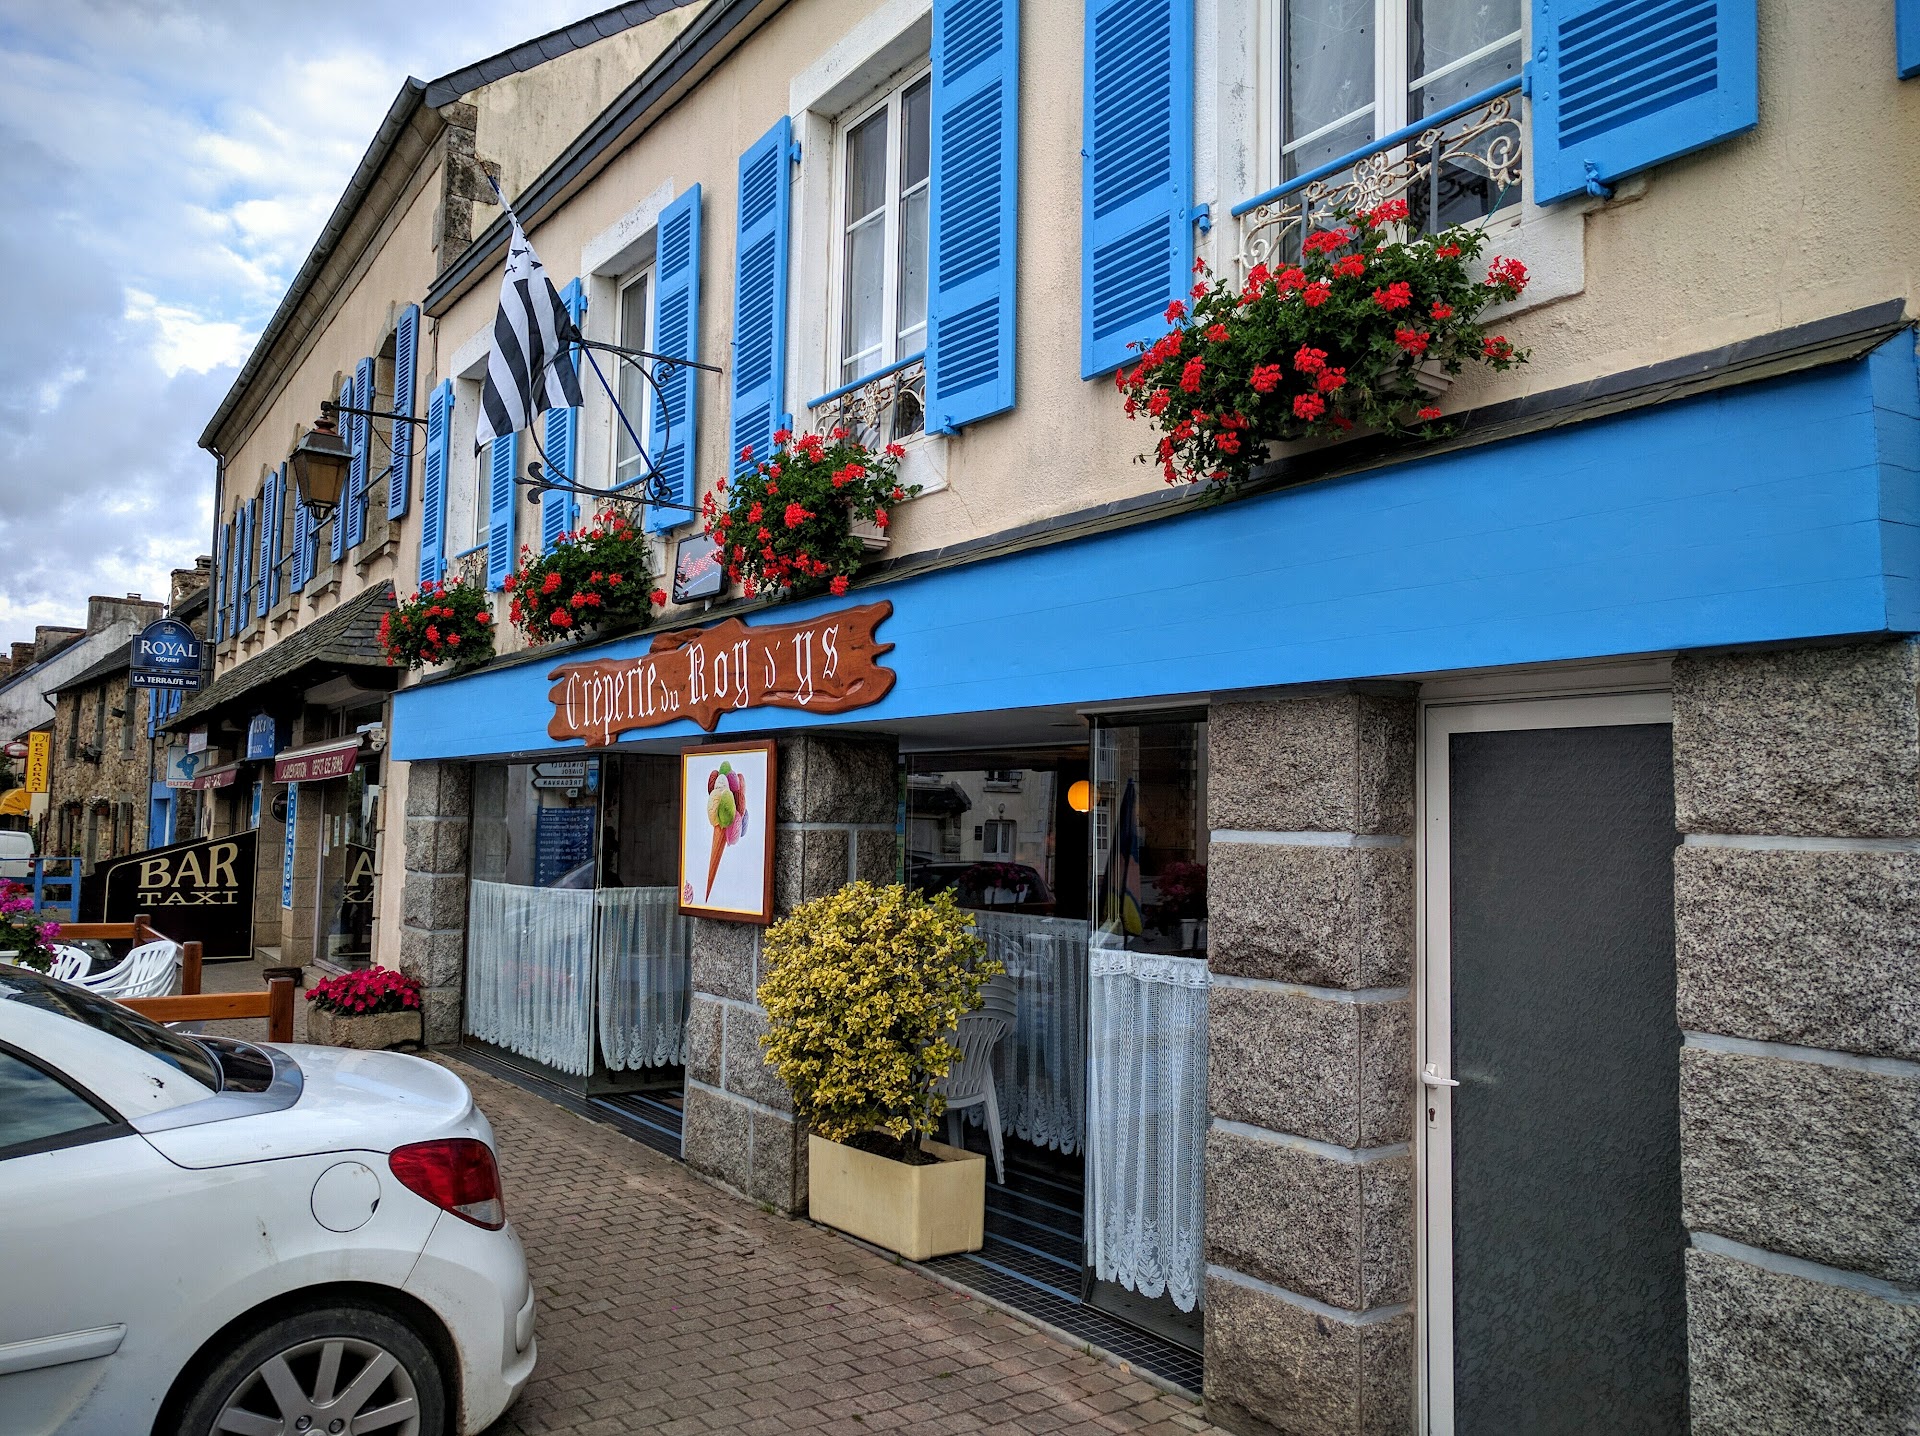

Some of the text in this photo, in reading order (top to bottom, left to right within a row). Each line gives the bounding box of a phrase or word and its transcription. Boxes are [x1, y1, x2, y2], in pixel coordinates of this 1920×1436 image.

[140, 640, 198, 658] ROYAL
[134, 675, 145, 683] LA
[147, 676, 184, 686] TERRASSE
[566, 658, 657, 746] Crêperie
[660, 679, 680, 712] du
[685, 639, 750, 708] Roy
[32, 742, 44, 792] RESTAURANT
[285, 794, 295, 888] ALIMENTATION
[137, 842, 239, 888] BAR
[137, 890, 238, 906] TAXI
